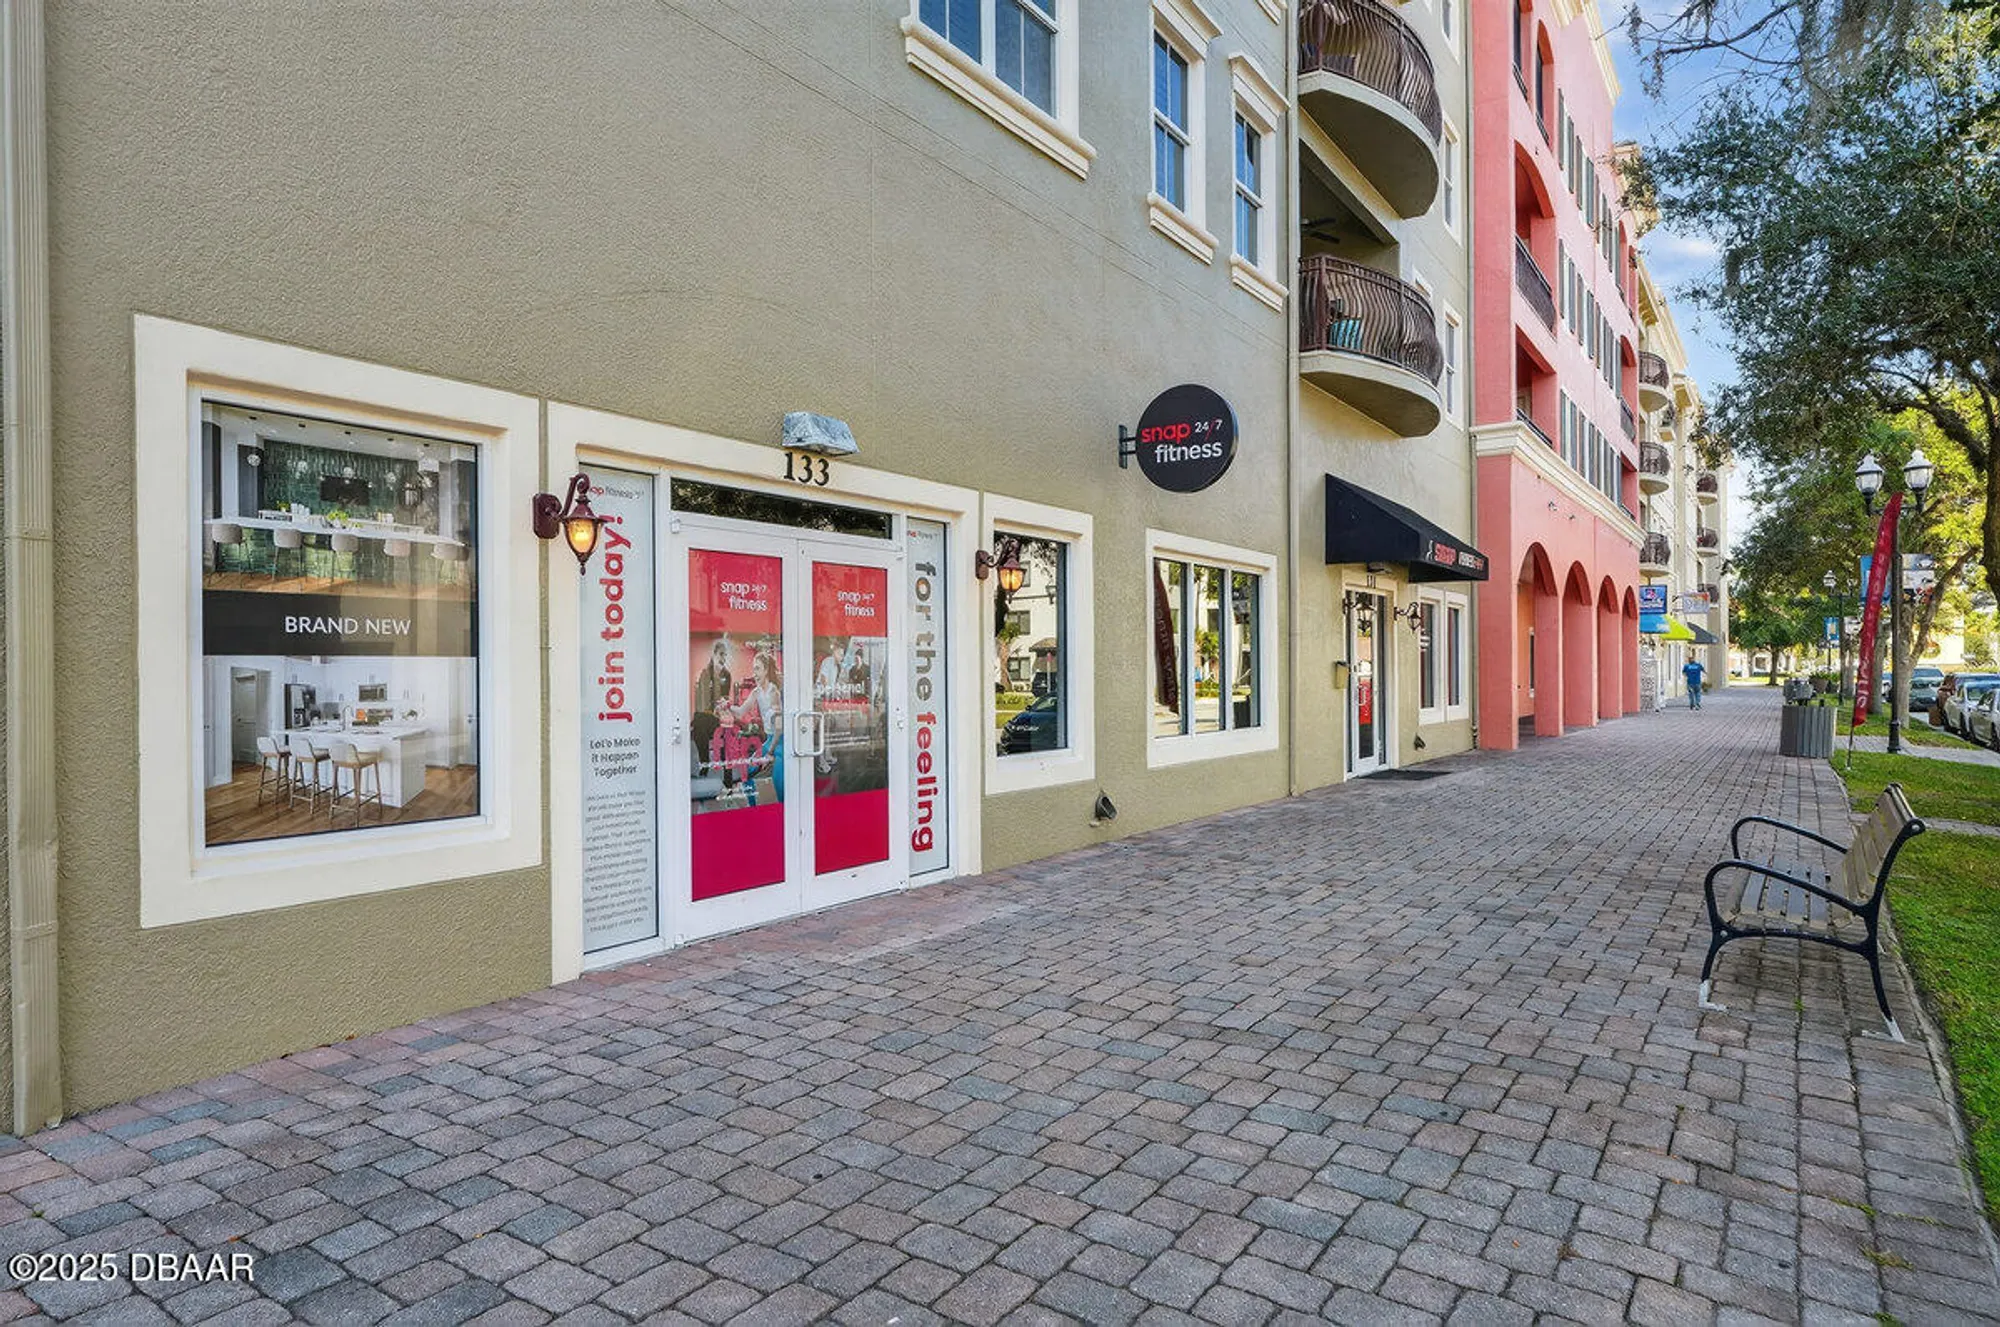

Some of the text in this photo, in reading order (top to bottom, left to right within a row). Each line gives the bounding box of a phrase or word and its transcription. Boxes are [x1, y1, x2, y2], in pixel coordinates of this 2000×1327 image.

[1141, 417, 1223, 444] snap 24/7
[1154, 441, 1223, 463] fitness
[783, 452, 830, 486] 133
[720, 581, 750, 598] snap
[729, 595, 768, 611] fitness
[915, 562, 936, 621] for
[284, 616, 412, 636] BRAND NEW
[916, 631, 936, 701] the
[598, 651, 633, 723] join
[911, 711, 938, 852] feeling
